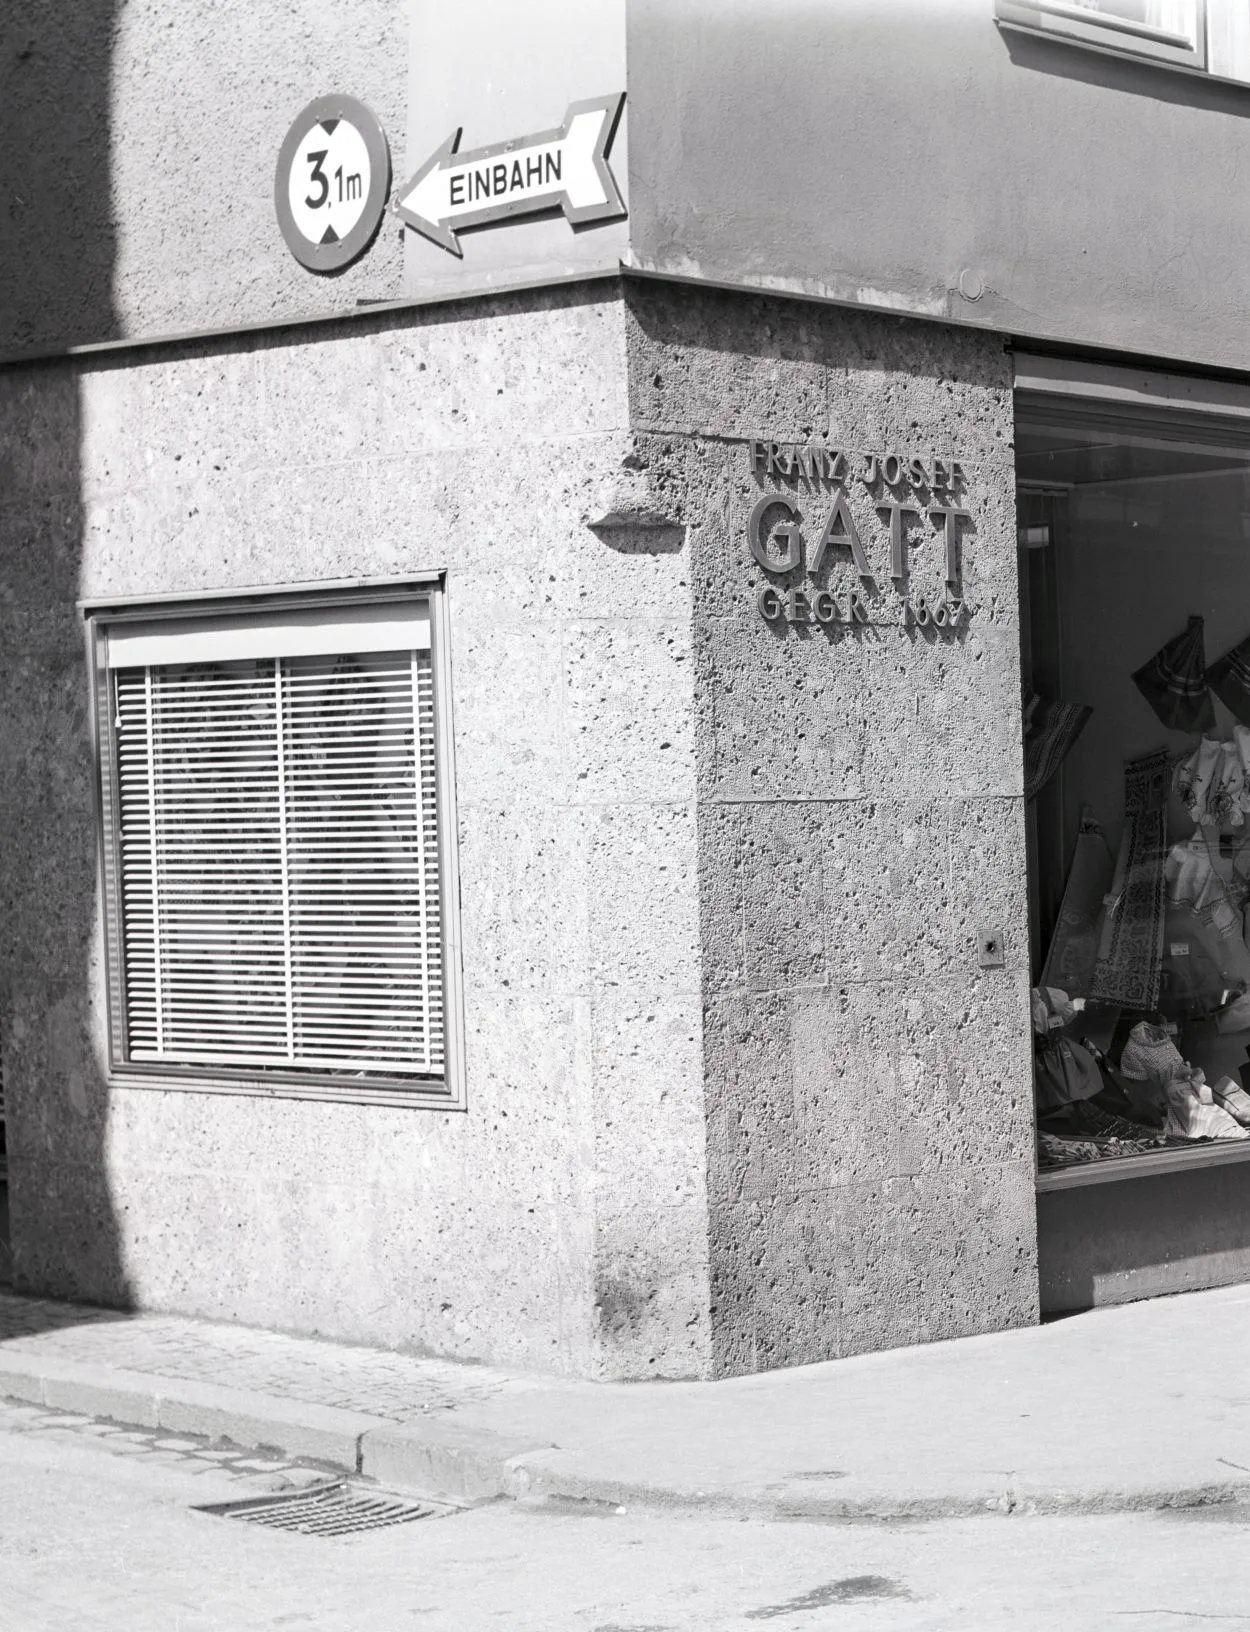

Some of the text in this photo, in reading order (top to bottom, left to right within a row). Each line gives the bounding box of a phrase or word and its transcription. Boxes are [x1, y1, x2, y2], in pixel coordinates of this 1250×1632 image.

[450, 150, 562, 206] EINBAHN
[750, 441, 962, 491] FRANZ JOSEF
[748, 488, 971, 583] GATT
[901, 597, 967, 627] 1867
